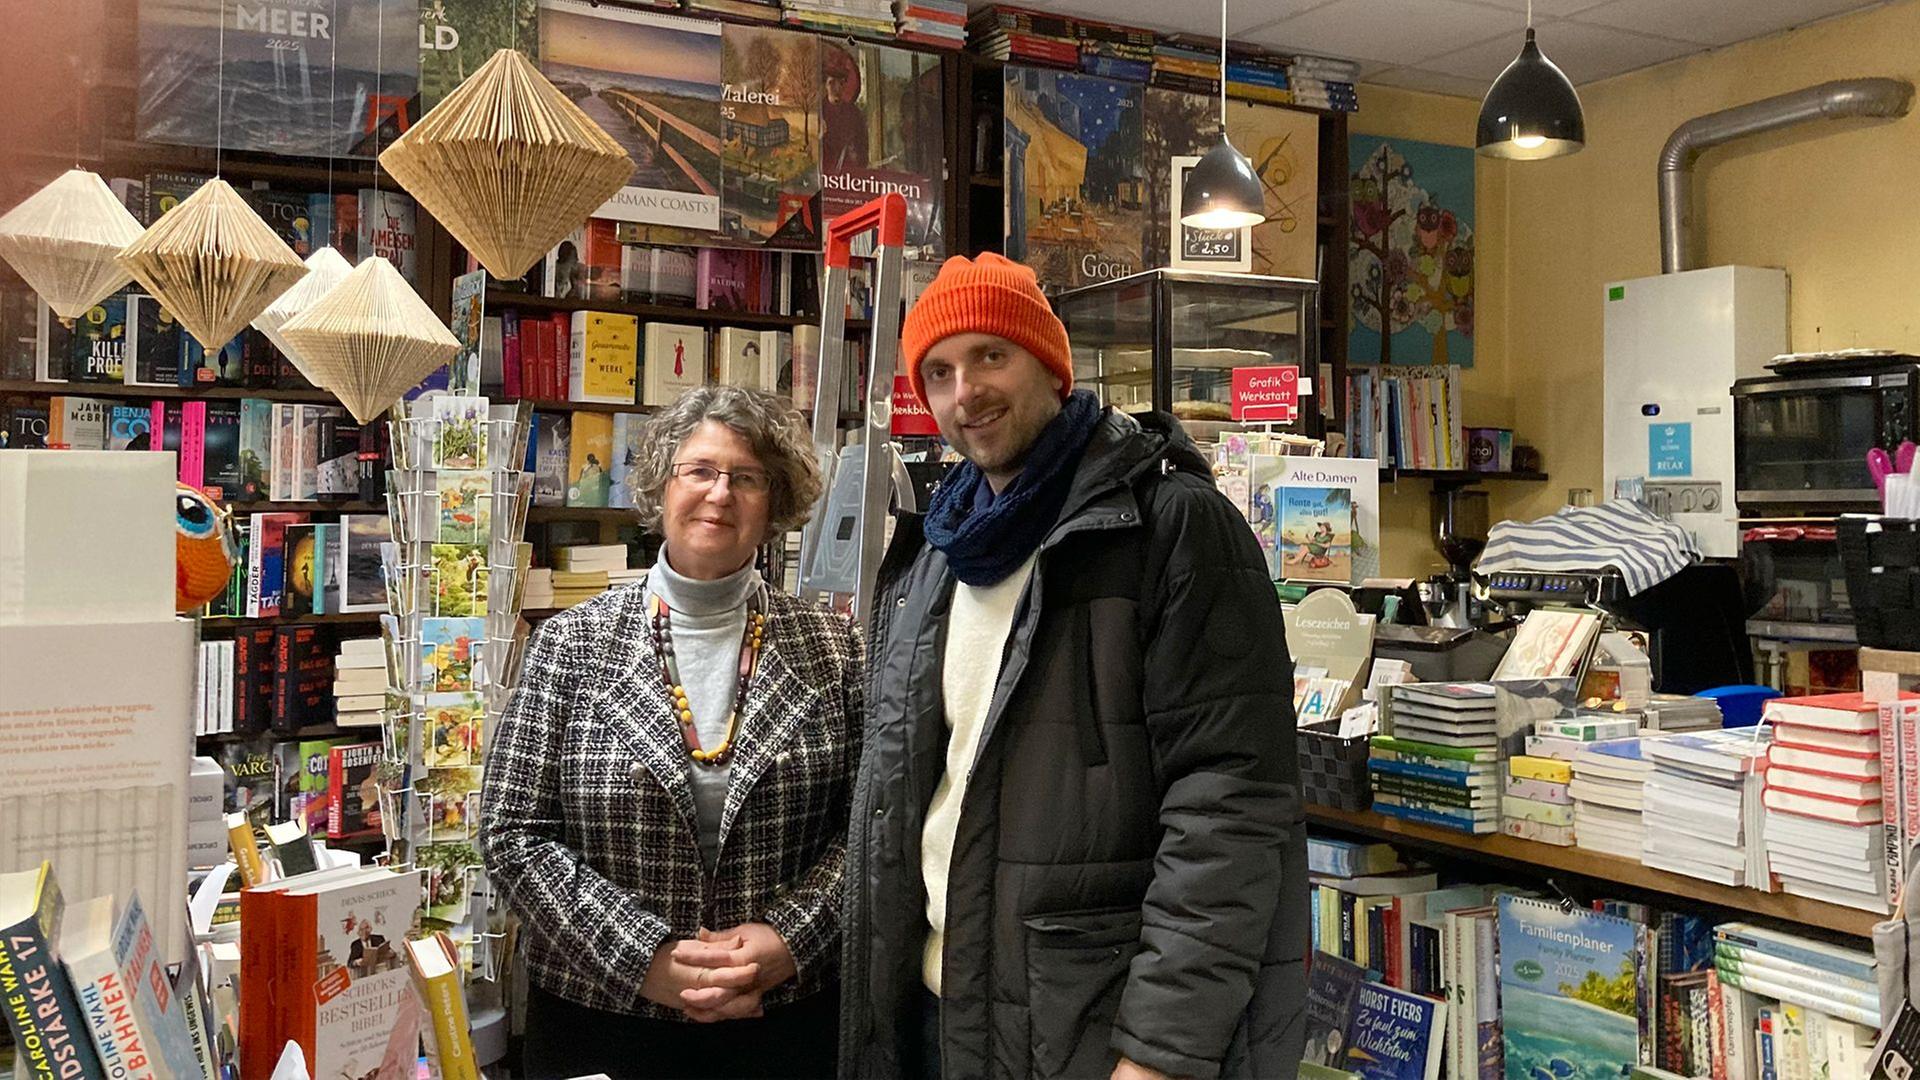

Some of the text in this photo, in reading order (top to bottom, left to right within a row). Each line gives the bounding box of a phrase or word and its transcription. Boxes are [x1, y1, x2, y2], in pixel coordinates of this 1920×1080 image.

[236, 3, 331, 40] MEER
[265, 38, 303, 51] 2025
[418, 24, 459, 50] LD
[157, 173, 187, 182] HELEN
[660, 200, 709, 213] COASTS
[370, 229, 415, 250] AMEISEN
[600, 365, 623, 374] WERKE
[1249, 376, 1281, 388] Grafik
[1239, 391, 1291, 402] Werkstatt
[113, 406, 150, 418] BENJA
[1657, 462, 1684, 471] RELAX
[1291, 471, 1358, 484] Alte Damen
[1289, 498, 1311, 507] Rente
[1295, 616, 1350, 631] Lesezeichen
[1886, 824, 1898, 867] CAMPINO
[342, 888, 397, 907] DENIS SCHECK
[1520, 919, 1614, 954] Familienplaner
[11, 937, 37, 961] 17
[82, 982, 104, 1029] WAHL
[1359, 987, 1390, 1013] HORST
[1391, 998, 1423, 1023] EVERS
[98, 972, 147, 1071] BAHNEN
[352, 1014, 385, 1033] BIBEL
[1356, 1009, 1418, 1041] Zu faul zum
[1726, 994, 1737, 1057] Damenopfer
[1357, 1031, 1411, 1063] Nichtstun
